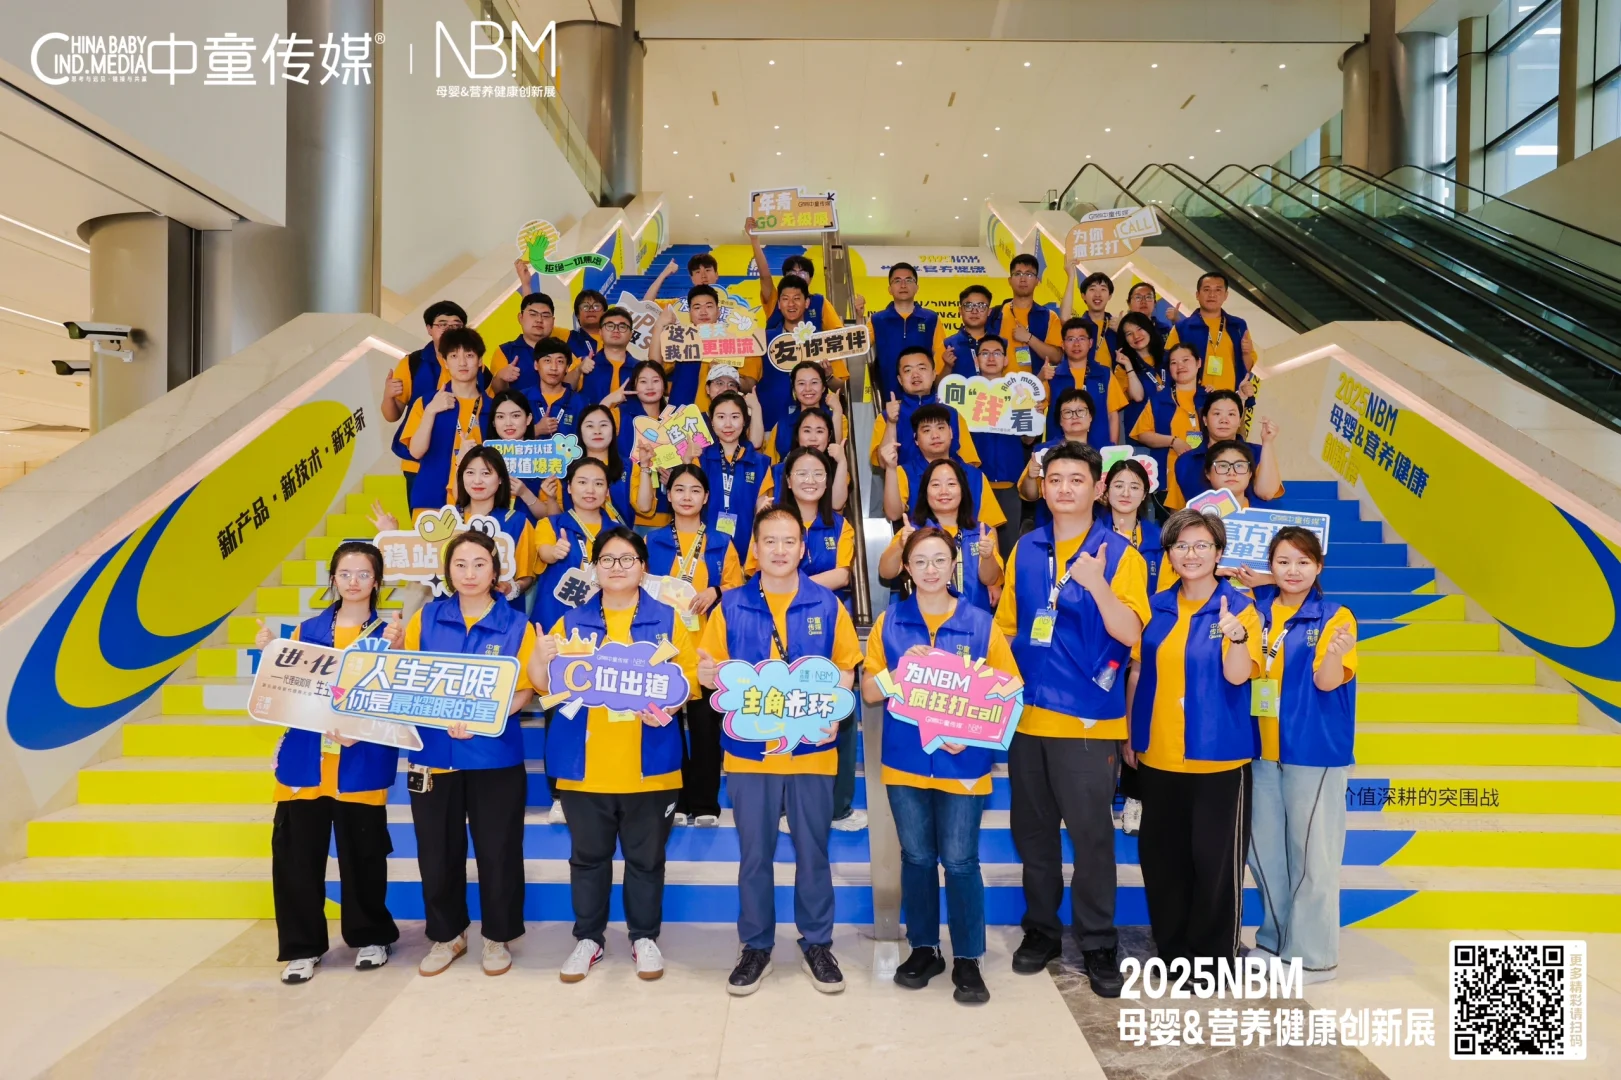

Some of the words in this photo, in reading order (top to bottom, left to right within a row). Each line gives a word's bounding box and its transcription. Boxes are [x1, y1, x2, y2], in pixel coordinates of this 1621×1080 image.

[757, 215, 777, 229] GO
[1073, 228, 1104, 243] 为你
[1119, 217, 1153, 237] CALL
[1073, 240, 1120, 259] 疯狂打
[1020, 376, 1041, 397] money
[1335, 371, 1399, 437] 2025NBM
[1329, 403, 1430, 499] 母婴&营养健康
[357, 655, 501, 700] 人生无限
[563, 660, 671, 700] C位出道
[815, 670, 833, 681] NBM
[904, 662, 971, 693] 为NBM
[346, 688, 500, 723] 你是最耀眼的星
[741, 685, 834, 719] 主角光环
[908, 687, 1003, 724] 疯狂打call
